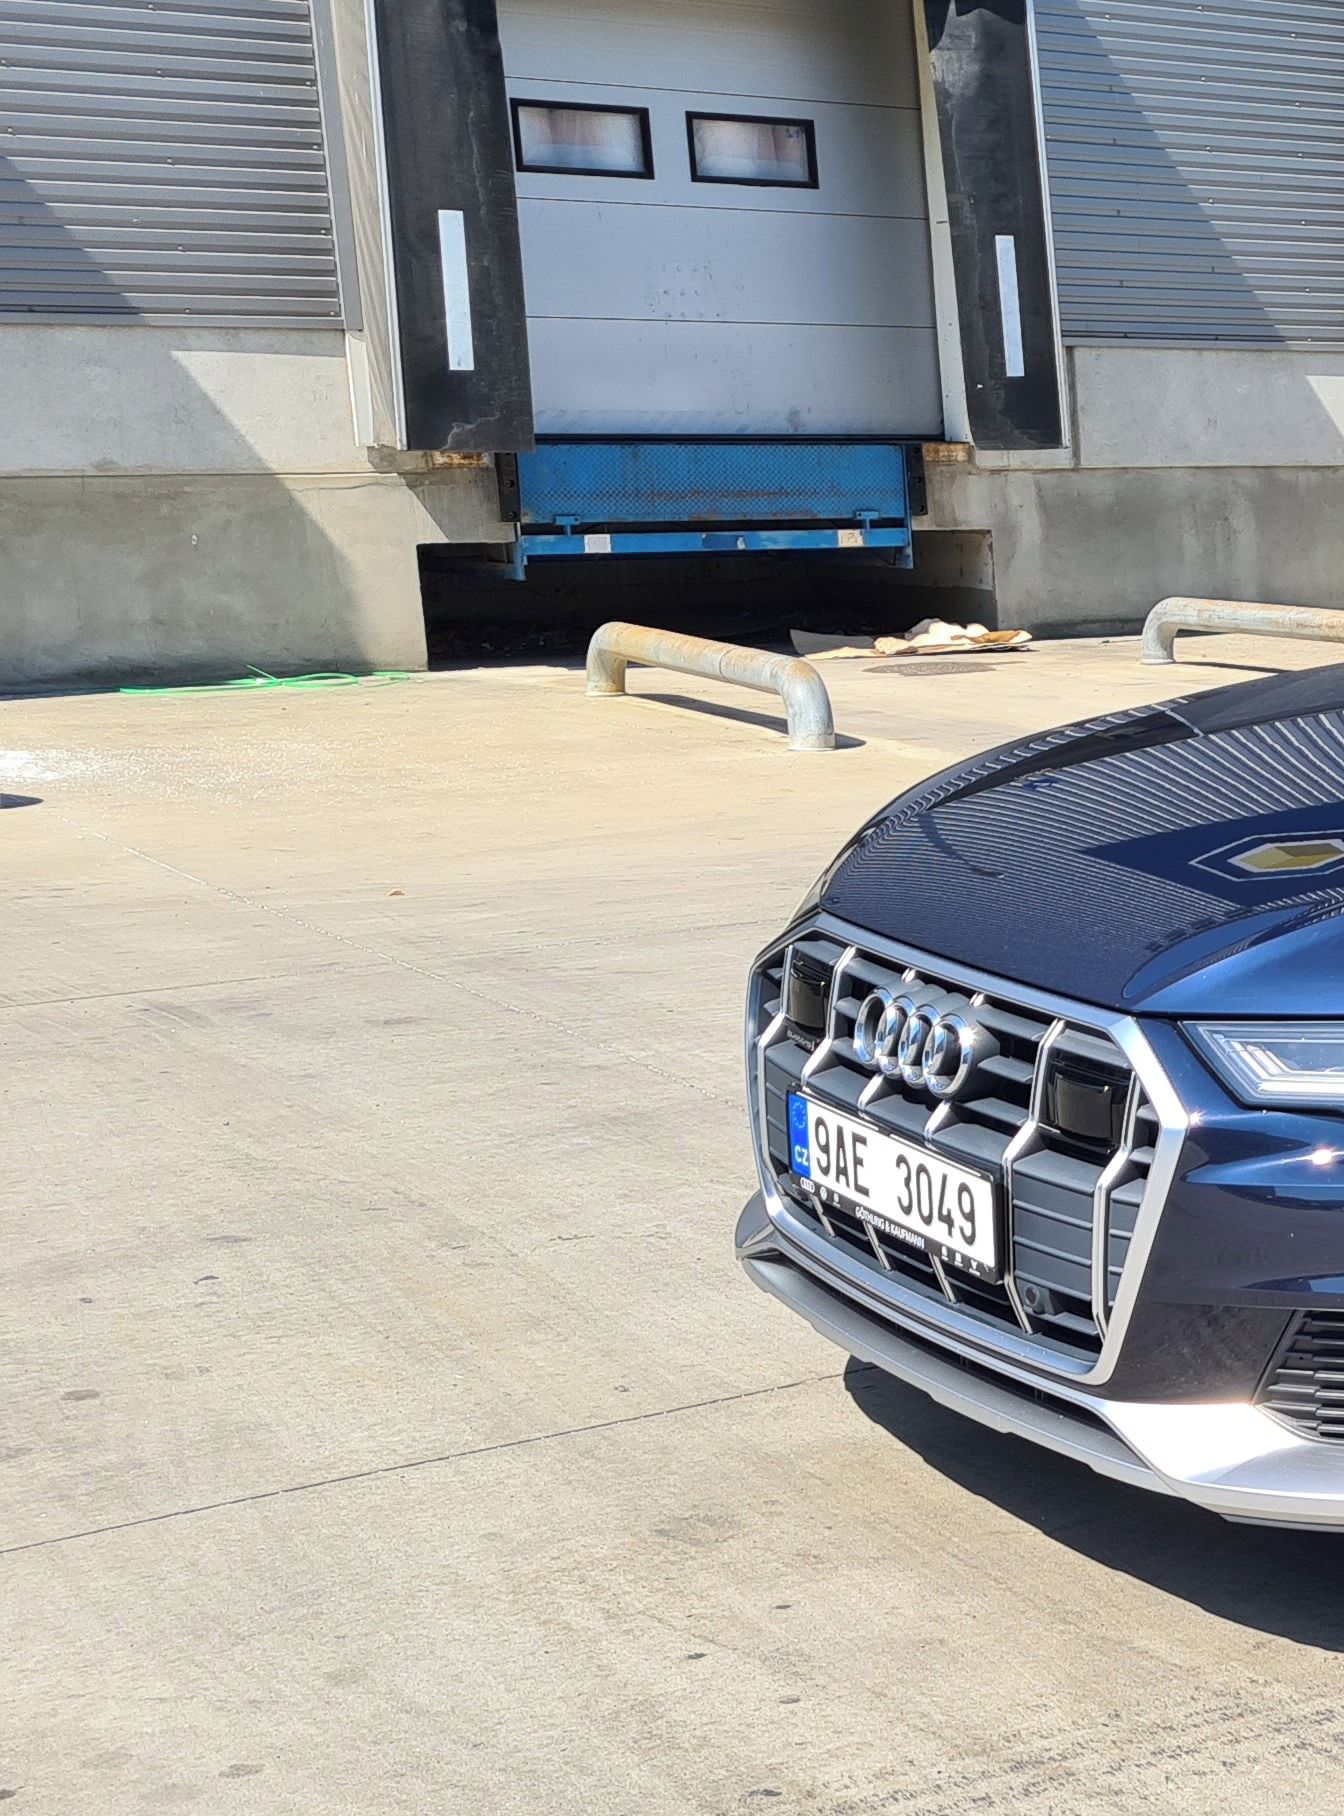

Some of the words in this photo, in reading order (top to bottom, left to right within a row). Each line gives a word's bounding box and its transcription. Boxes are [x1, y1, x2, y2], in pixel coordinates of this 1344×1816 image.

[794, 1145, 809, 1167] CZ
[814, 1116, 870, 1198] 9AE
[895, 1153, 977, 1247] 3049
